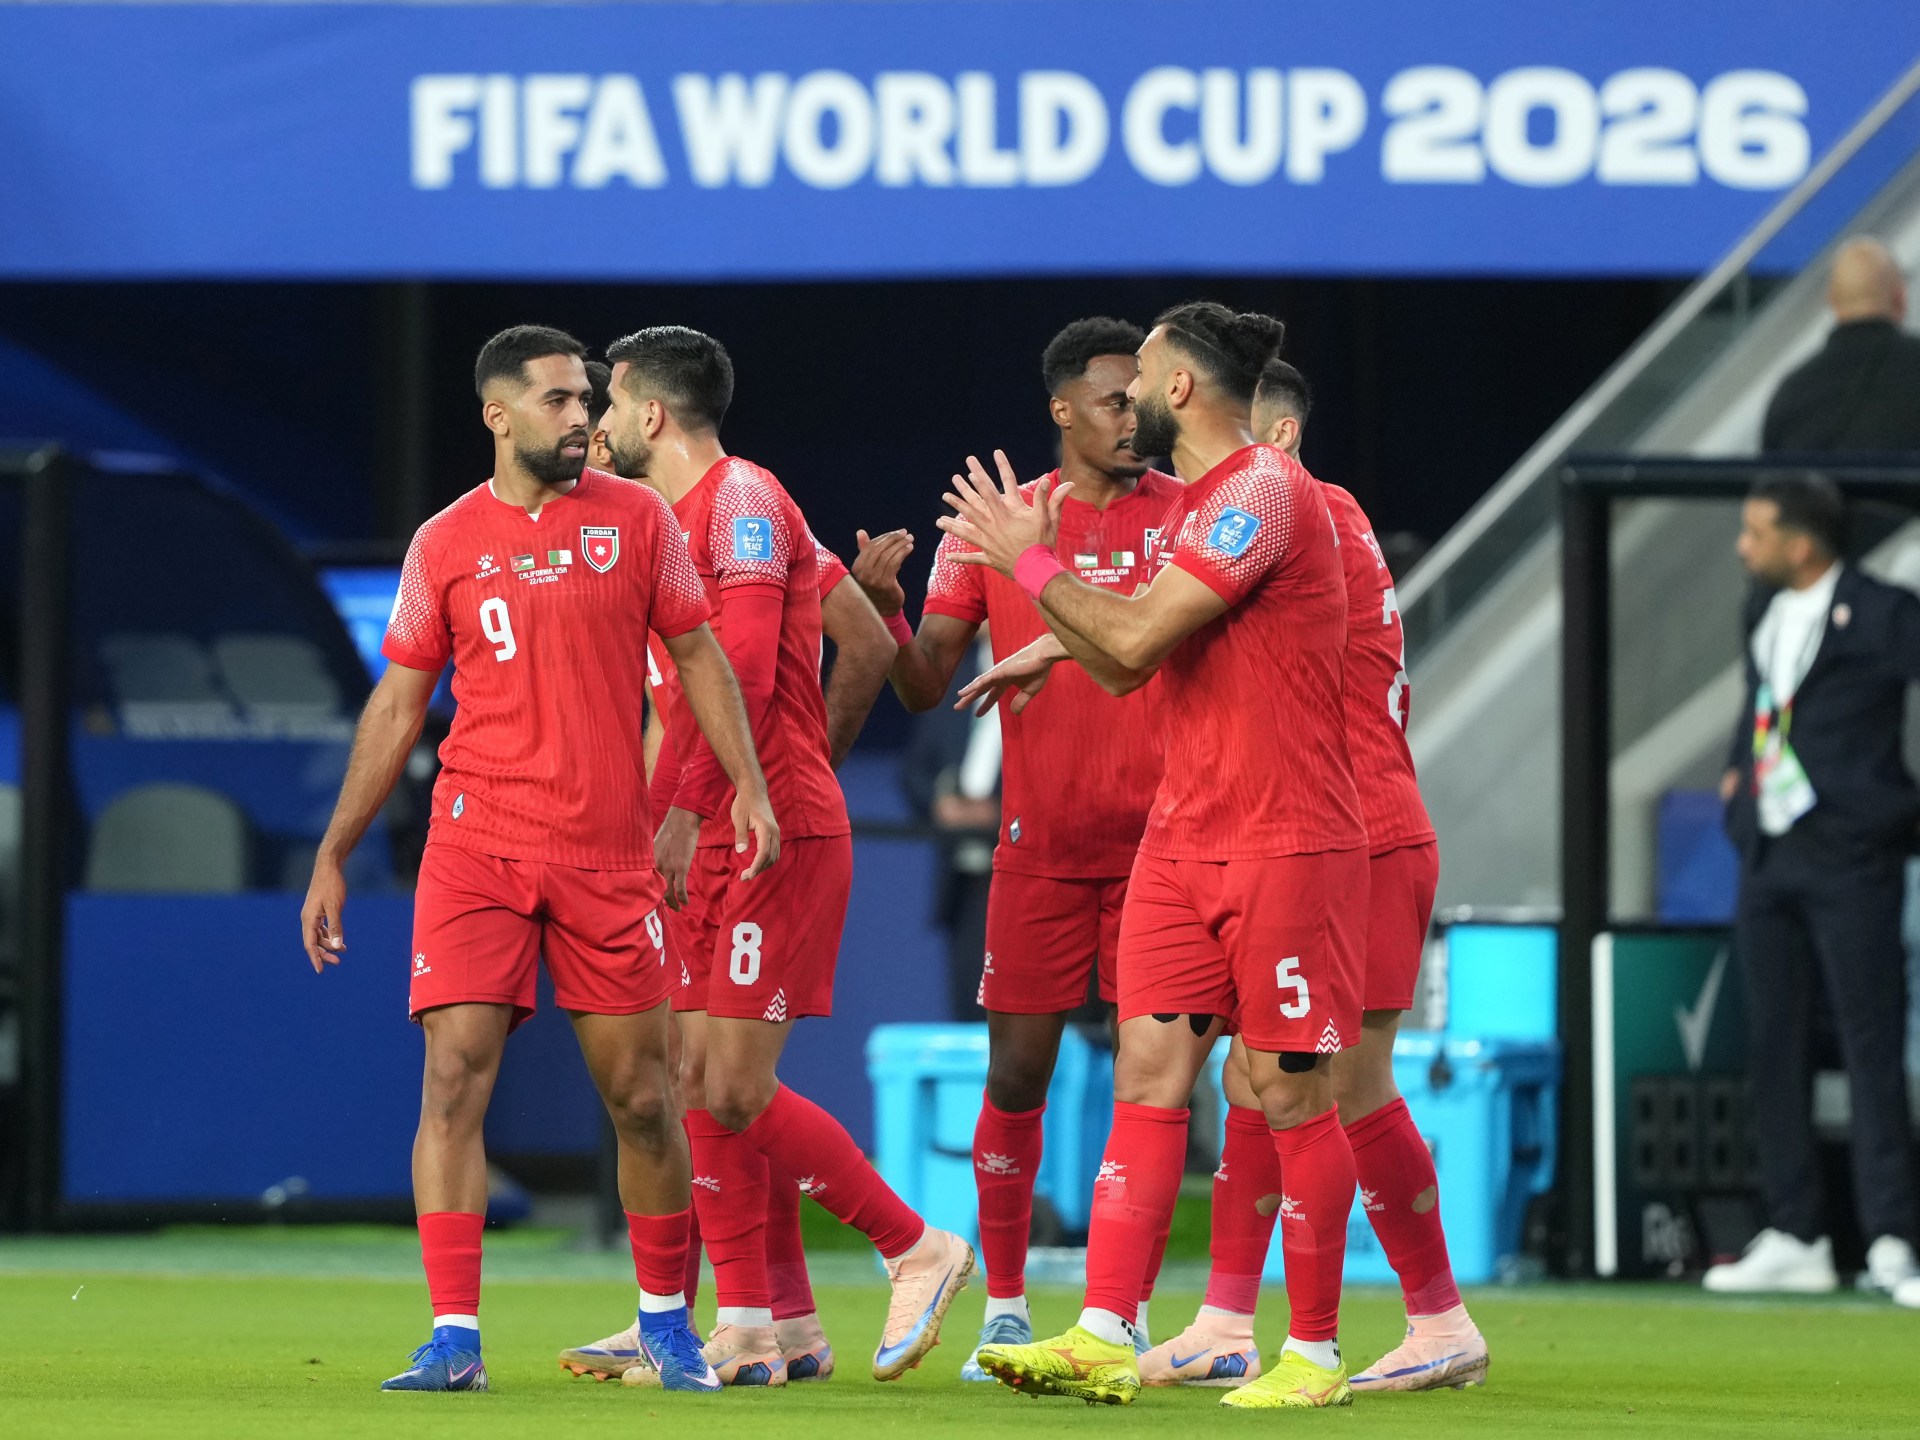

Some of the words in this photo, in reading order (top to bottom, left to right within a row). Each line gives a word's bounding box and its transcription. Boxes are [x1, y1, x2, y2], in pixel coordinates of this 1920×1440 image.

[409, 73, 669, 189] FIFA
[670, 69, 1110, 189] WORLD
[1121, 65, 1368, 187] CUP
[1380, 64, 1811, 191] 2026
[744, 542, 762, 551] PEACE
[475, 566, 501, 580] KELME
[555, 566, 568, 574] USA
[529, 575, 559, 585] 22/6/2026
[479, 597, 517, 662] 9
[729, 922, 762, 985] 8
[1276, 956, 1311, 1019] 5
[977, 1161, 1020, 1175] KELME
